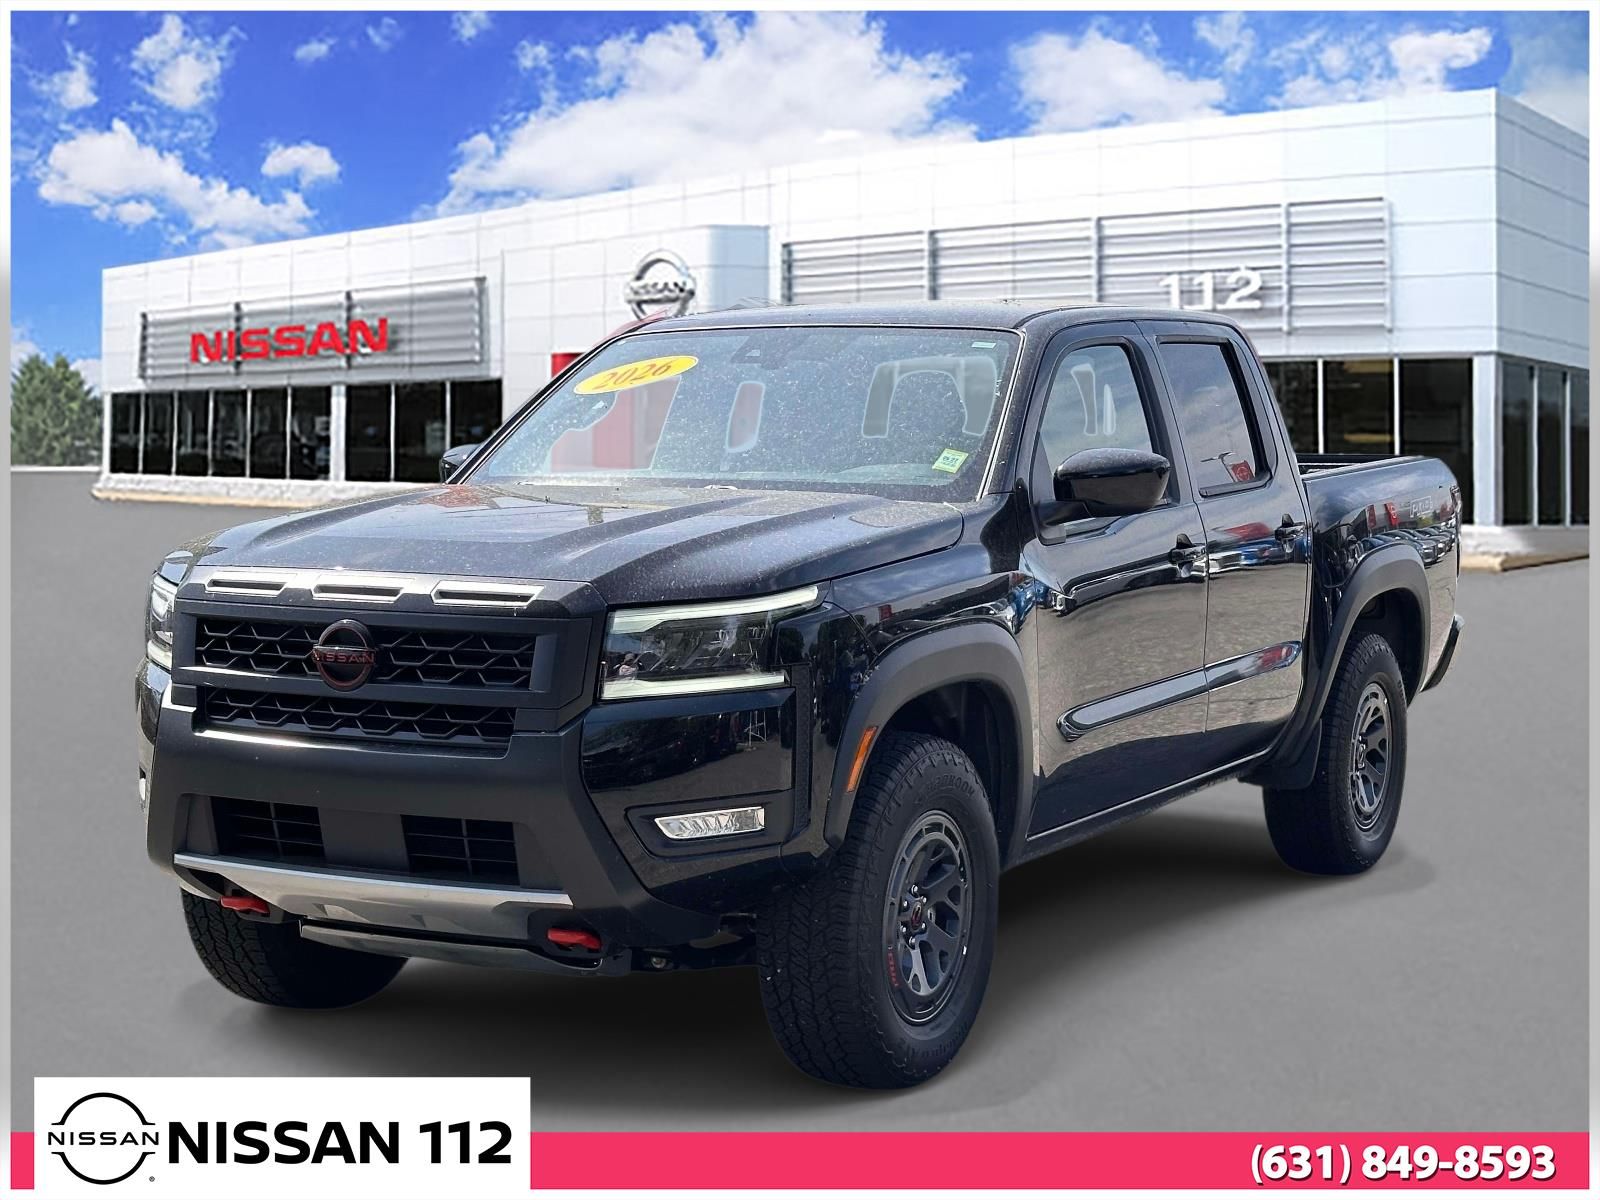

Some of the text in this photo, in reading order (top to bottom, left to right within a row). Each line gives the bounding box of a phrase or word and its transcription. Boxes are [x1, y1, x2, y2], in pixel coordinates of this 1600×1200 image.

[628, 280, 690, 298] NISSAN
[1158, 269, 1262, 311] 112
[190, 316, 388, 363] NISSAN
[592, 358, 679, 390] 2026
